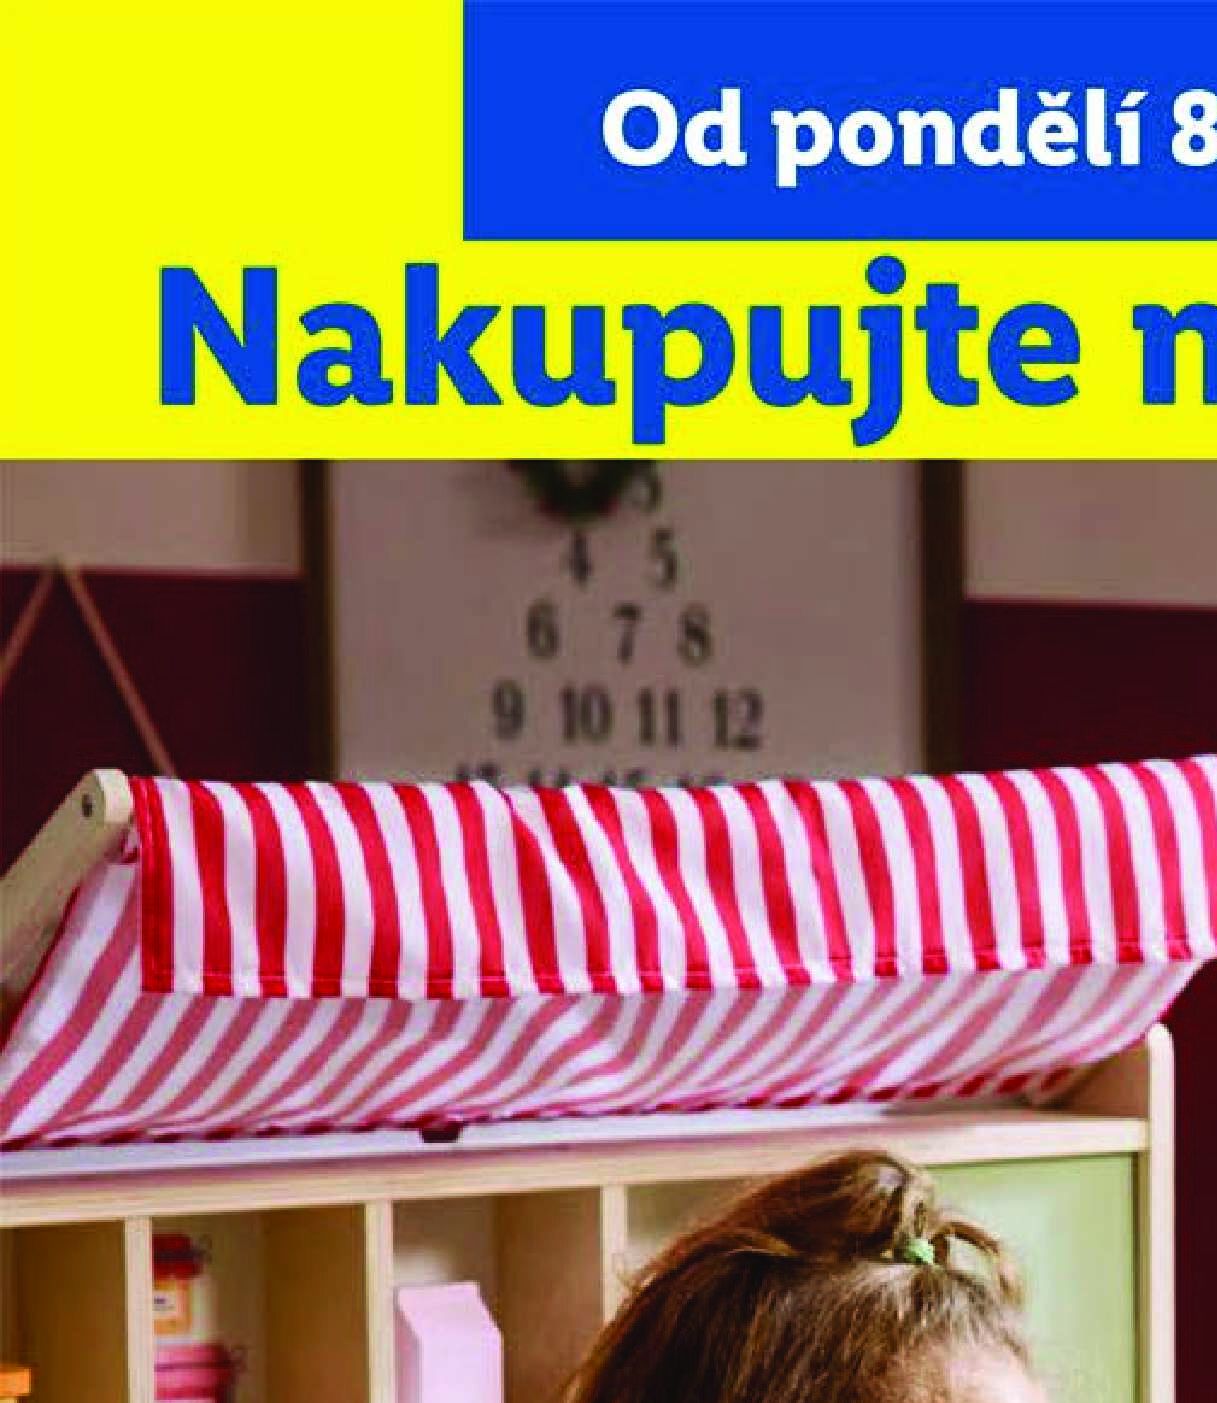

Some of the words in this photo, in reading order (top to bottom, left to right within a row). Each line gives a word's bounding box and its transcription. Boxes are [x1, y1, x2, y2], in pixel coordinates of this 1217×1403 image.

[602, 88, 748, 167] Od
[770, 88, 1148, 187] pondělí
[160, 255, 1079, 444] Nakupujte
[565, 529, 593, 586] 4
[649, 527, 678, 589] 5
[525, 602, 557, 660] 6
[613, 605, 641, 664] 7
[678, 607, 712, 666] 8
[492, 682, 526, 739] 9
[558, 685, 613, 743] 10
[636, 688, 681, 747] 11
[713, 688, 766, 750] 12
